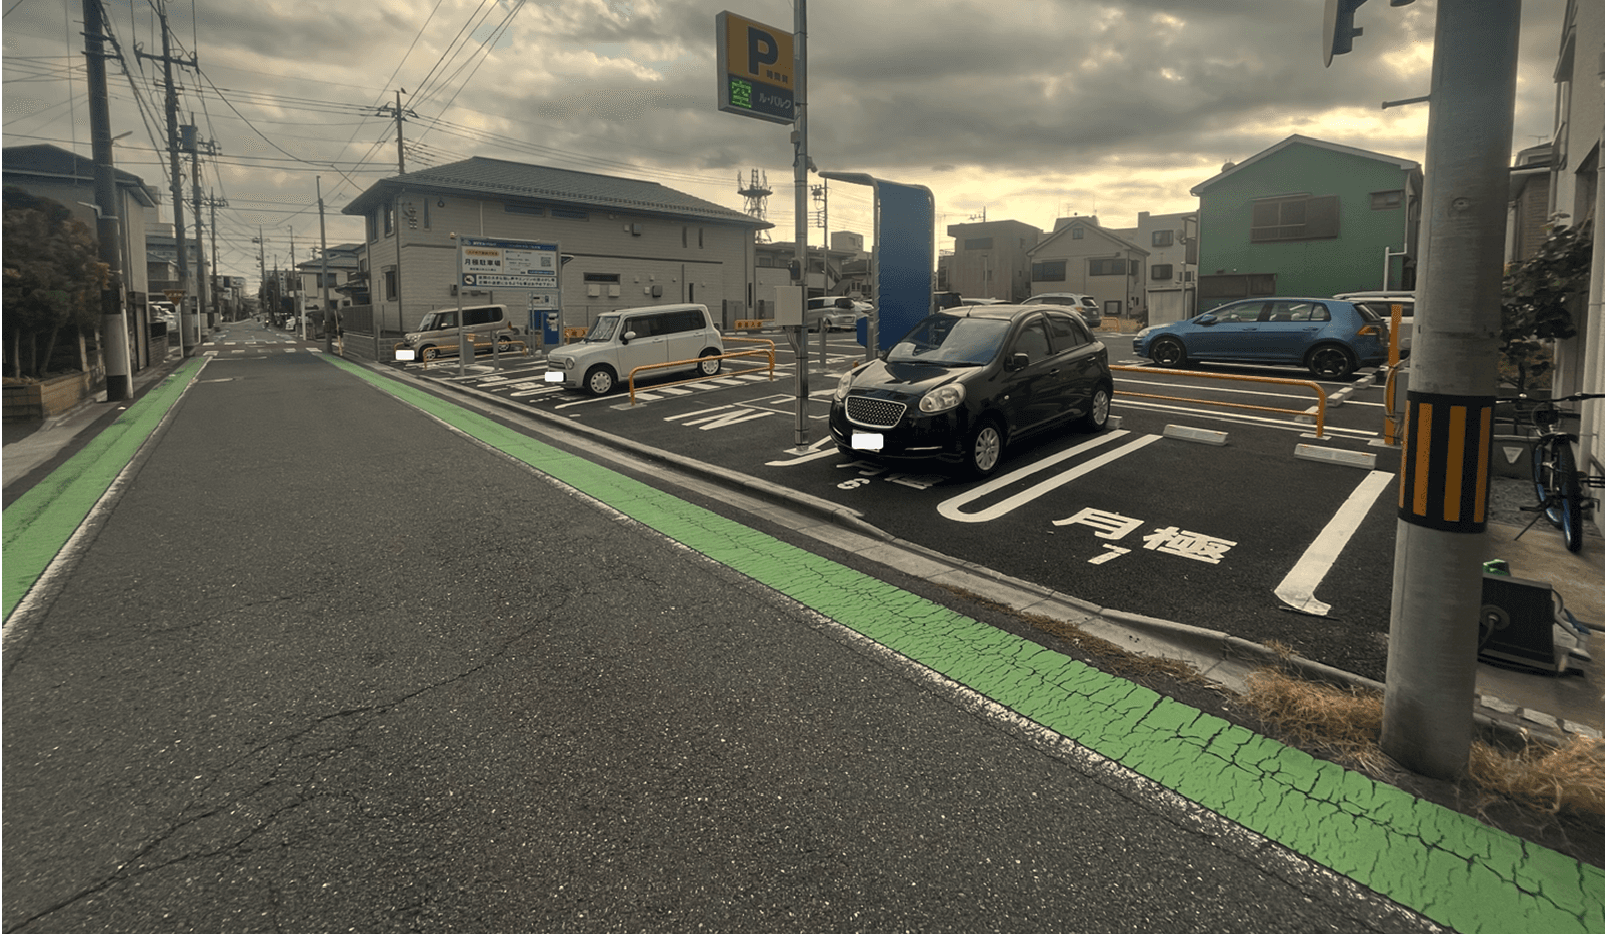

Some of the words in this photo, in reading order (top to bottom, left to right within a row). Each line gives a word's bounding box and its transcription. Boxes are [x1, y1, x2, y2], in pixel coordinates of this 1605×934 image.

[748, 26, 779, 75] P
[731, 79, 752, 109] 空
[464, 258, 501, 267] 月極駐車場
[1052, 506, 1239, 565] 月極
[1087, 543, 1133, 565] 7
